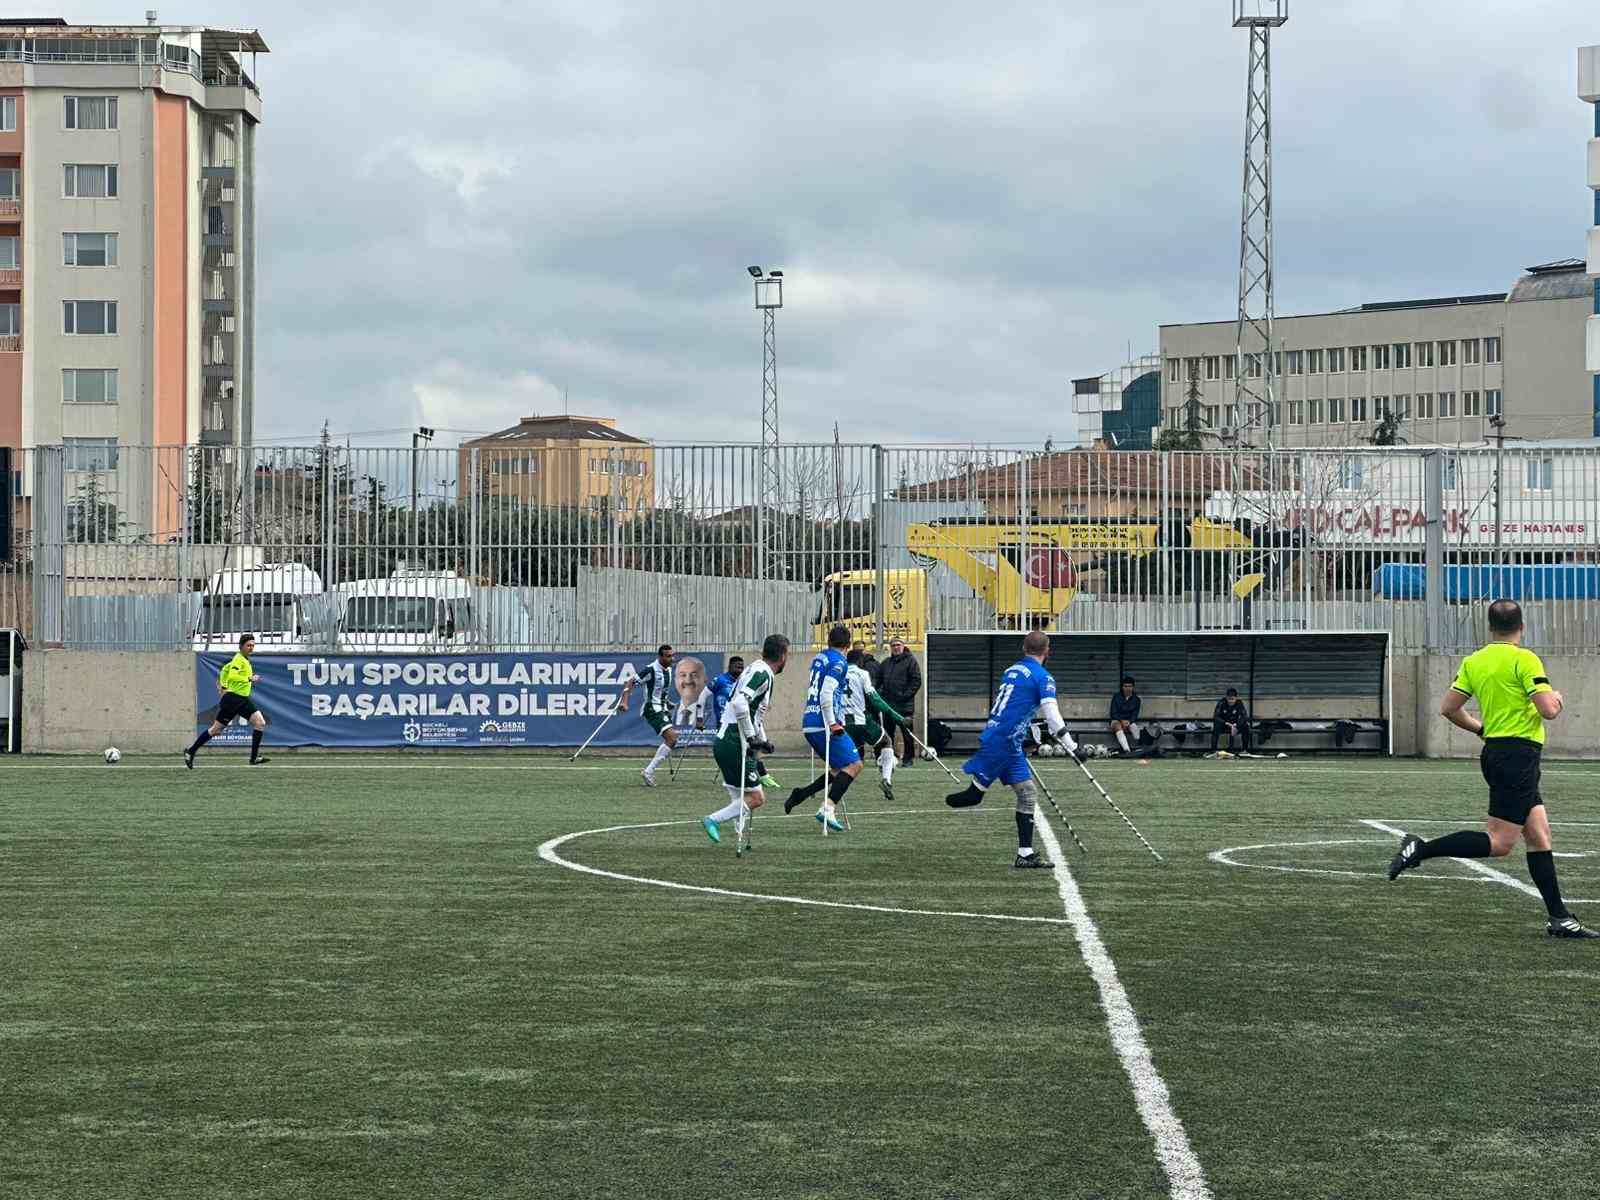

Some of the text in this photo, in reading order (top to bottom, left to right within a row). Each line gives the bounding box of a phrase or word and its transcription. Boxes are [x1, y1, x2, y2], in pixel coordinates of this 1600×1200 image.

[1480, 524, 1519, 533] GEZE
[287, 658, 637, 685] TÜM SPORCULARIMIZA
[311, 688, 618, 720] BAŞARILAR DİLERİZ
